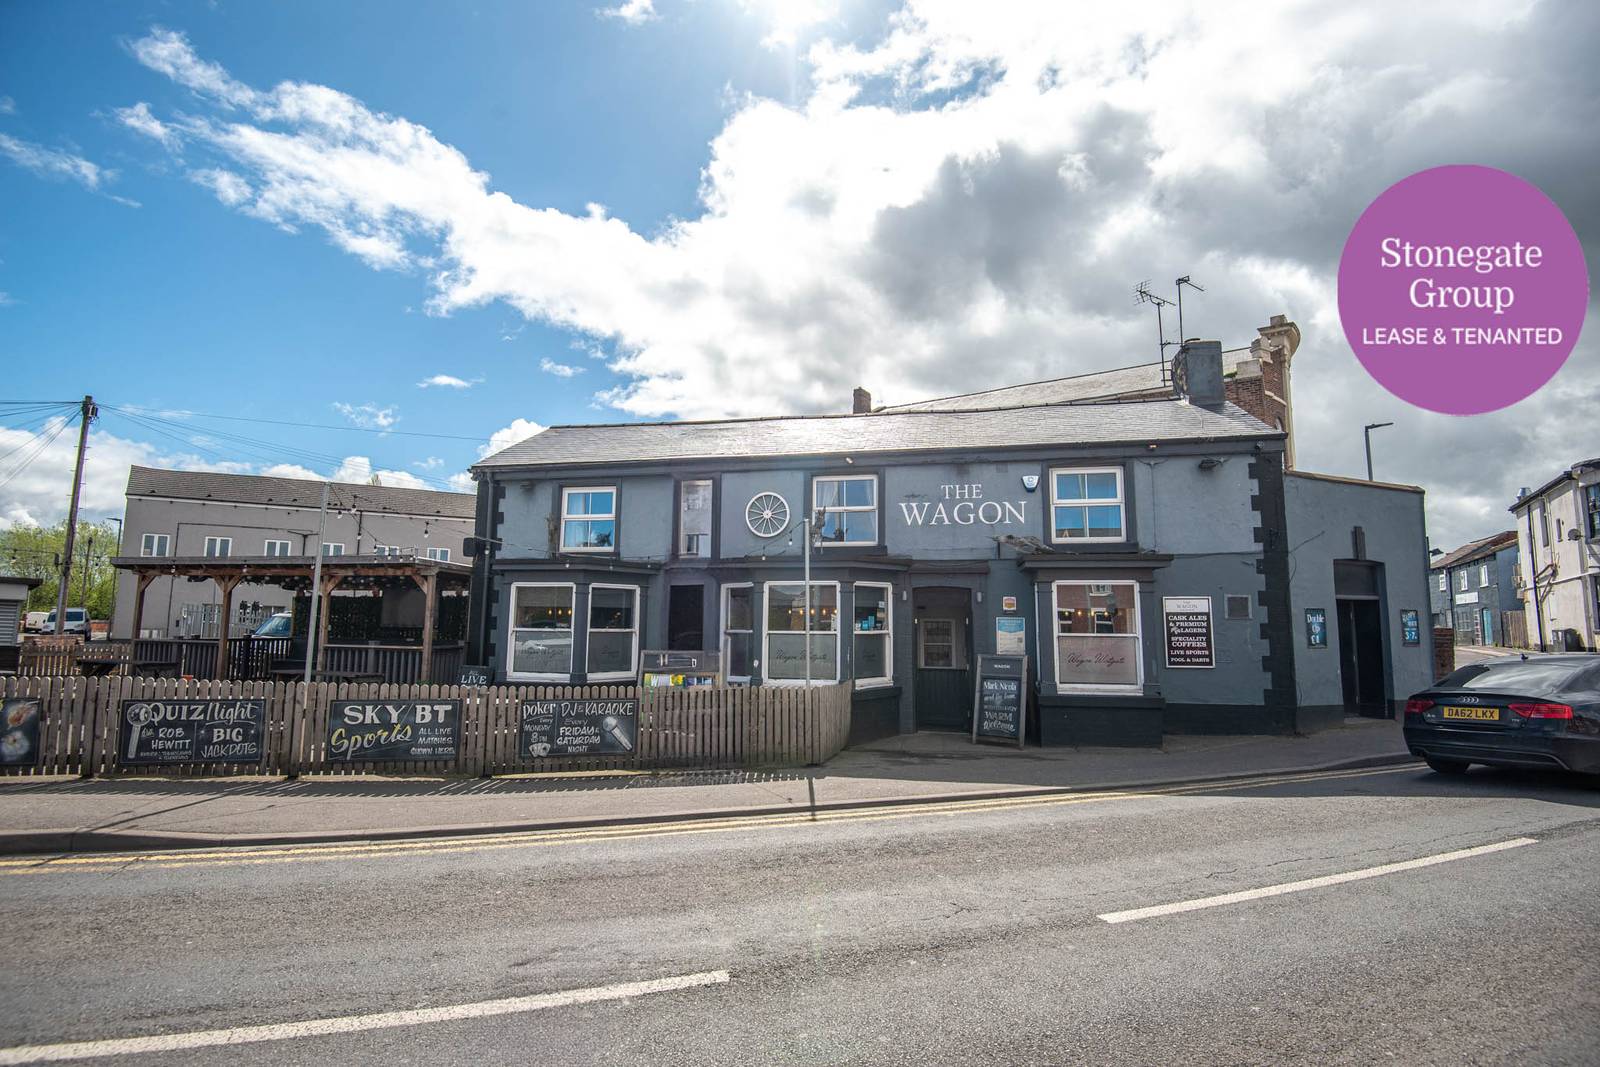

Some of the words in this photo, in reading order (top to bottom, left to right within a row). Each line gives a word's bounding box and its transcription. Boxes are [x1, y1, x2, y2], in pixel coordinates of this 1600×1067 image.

[941, 484, 983, 499] THE
[898, 501, 1028, 526] WAGON
[460, 674, 487, 684] LIVE
[149, 702, 205, 725] QUIZ
[344, 704, 406, 725] SKY
[415, 704, 452, 724] BT
[561, 702, 577, 717] DJ
[585, 702, 634, 716] KARAOKE
[1447, 708, 1473, 718] DA62
[1474, 709, 1495, 719] LKX
[159, 727, 185, 738] ROB
[418, 727, 432, 735] ALL
[434, 727, 452, 735] LIVE
[524, 724, 551, 732] MONDAY
[560, 726, 595, 736] FRIDAY
[212, 728, 243, 742] BIG
[530, 732, 538, 742] 8
[556, 736, 601, 745] SATURDAY
[151, 739, 191, 750] HEWITT
[331, 723, 413, 760] Sports
[200, 742, 257, 758] JACKPOTS
[567, 745, 588, 753] NIGHT
